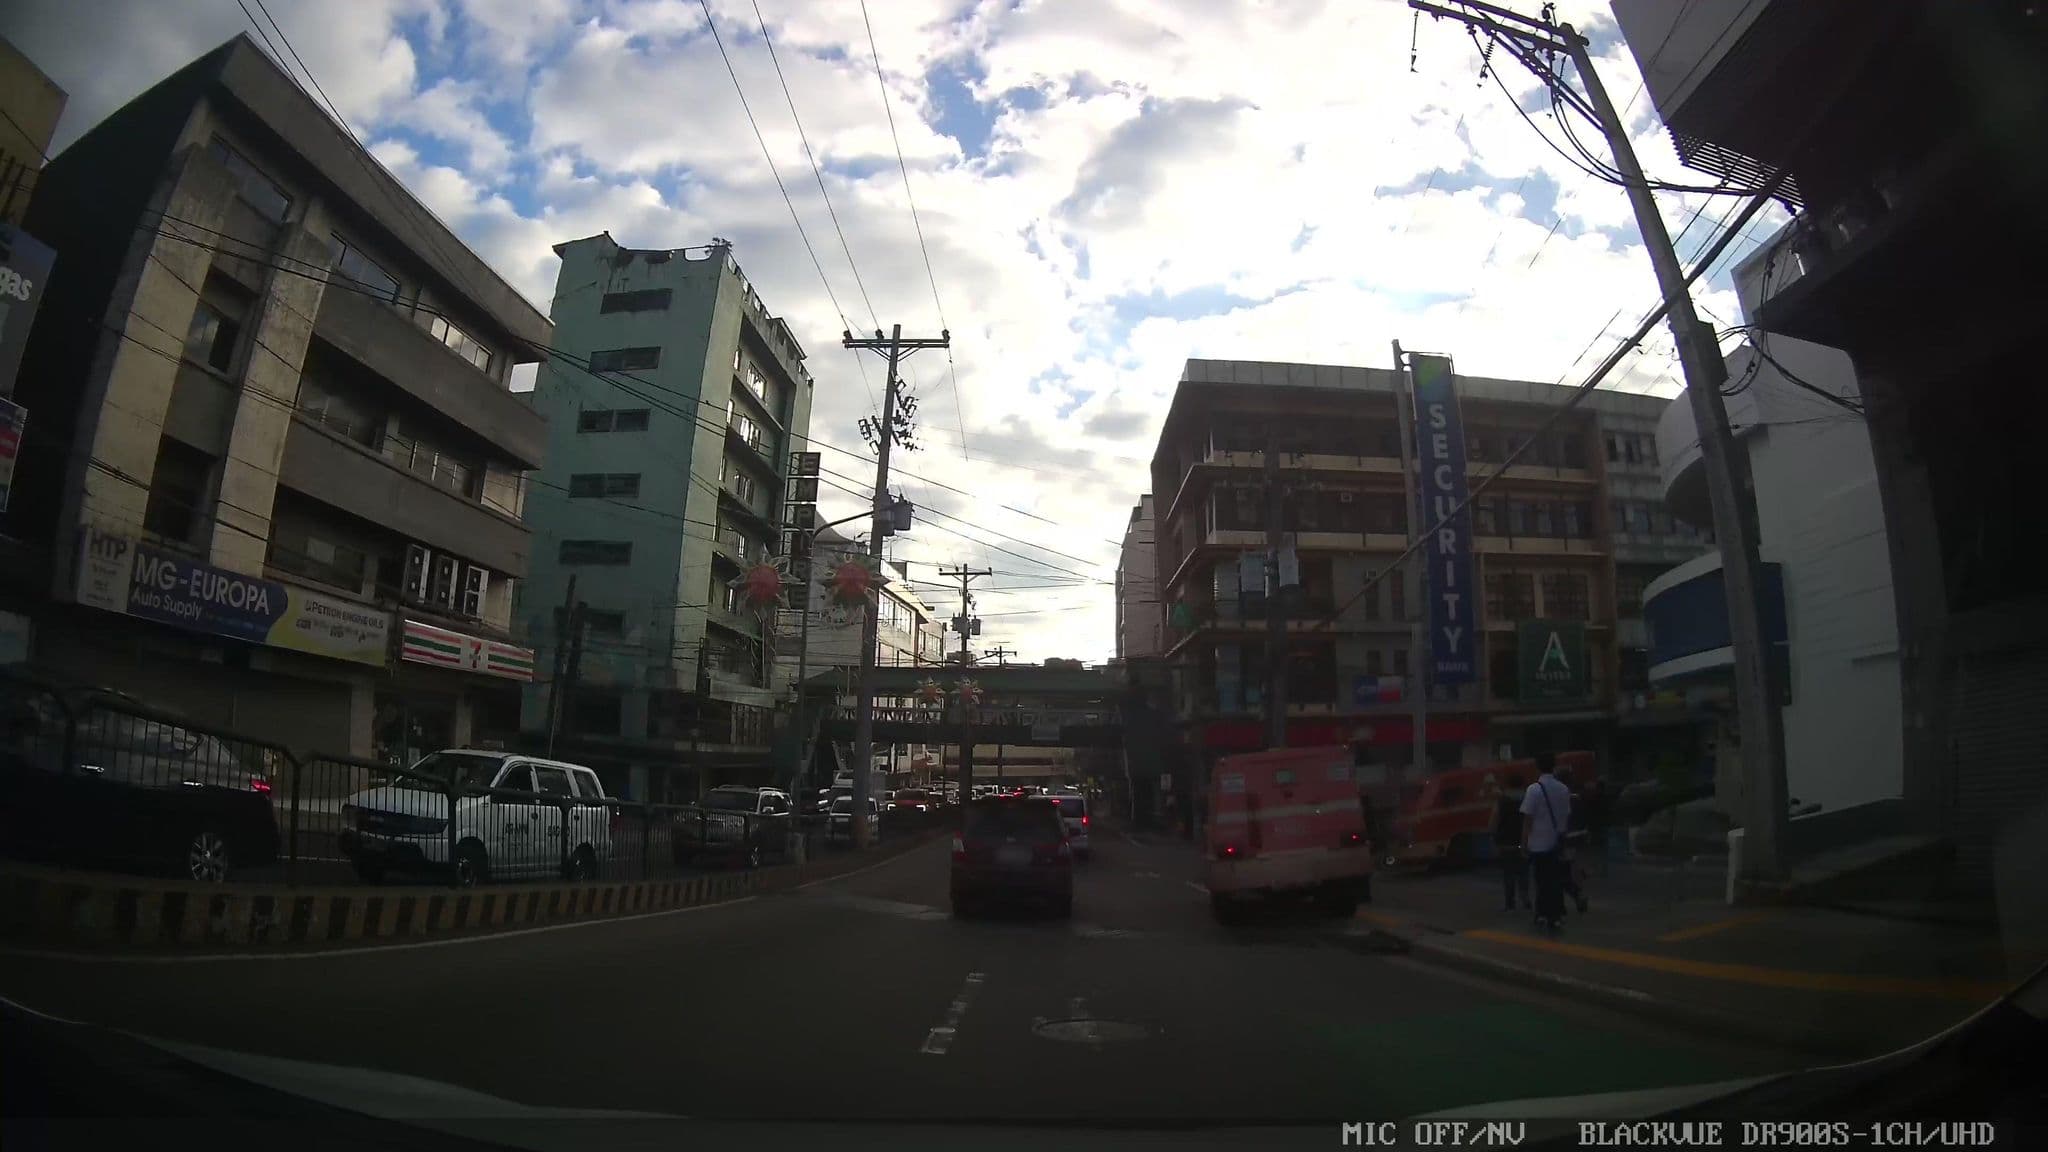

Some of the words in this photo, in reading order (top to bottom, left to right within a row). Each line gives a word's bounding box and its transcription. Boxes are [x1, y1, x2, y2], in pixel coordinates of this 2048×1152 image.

[1428, 403, 1463, 654] SECURITY
[131, 586, 160, 608] Auto
[163, 594, 202, 620] Supply
[135, 553, 270, 615] MG-EUROPA
